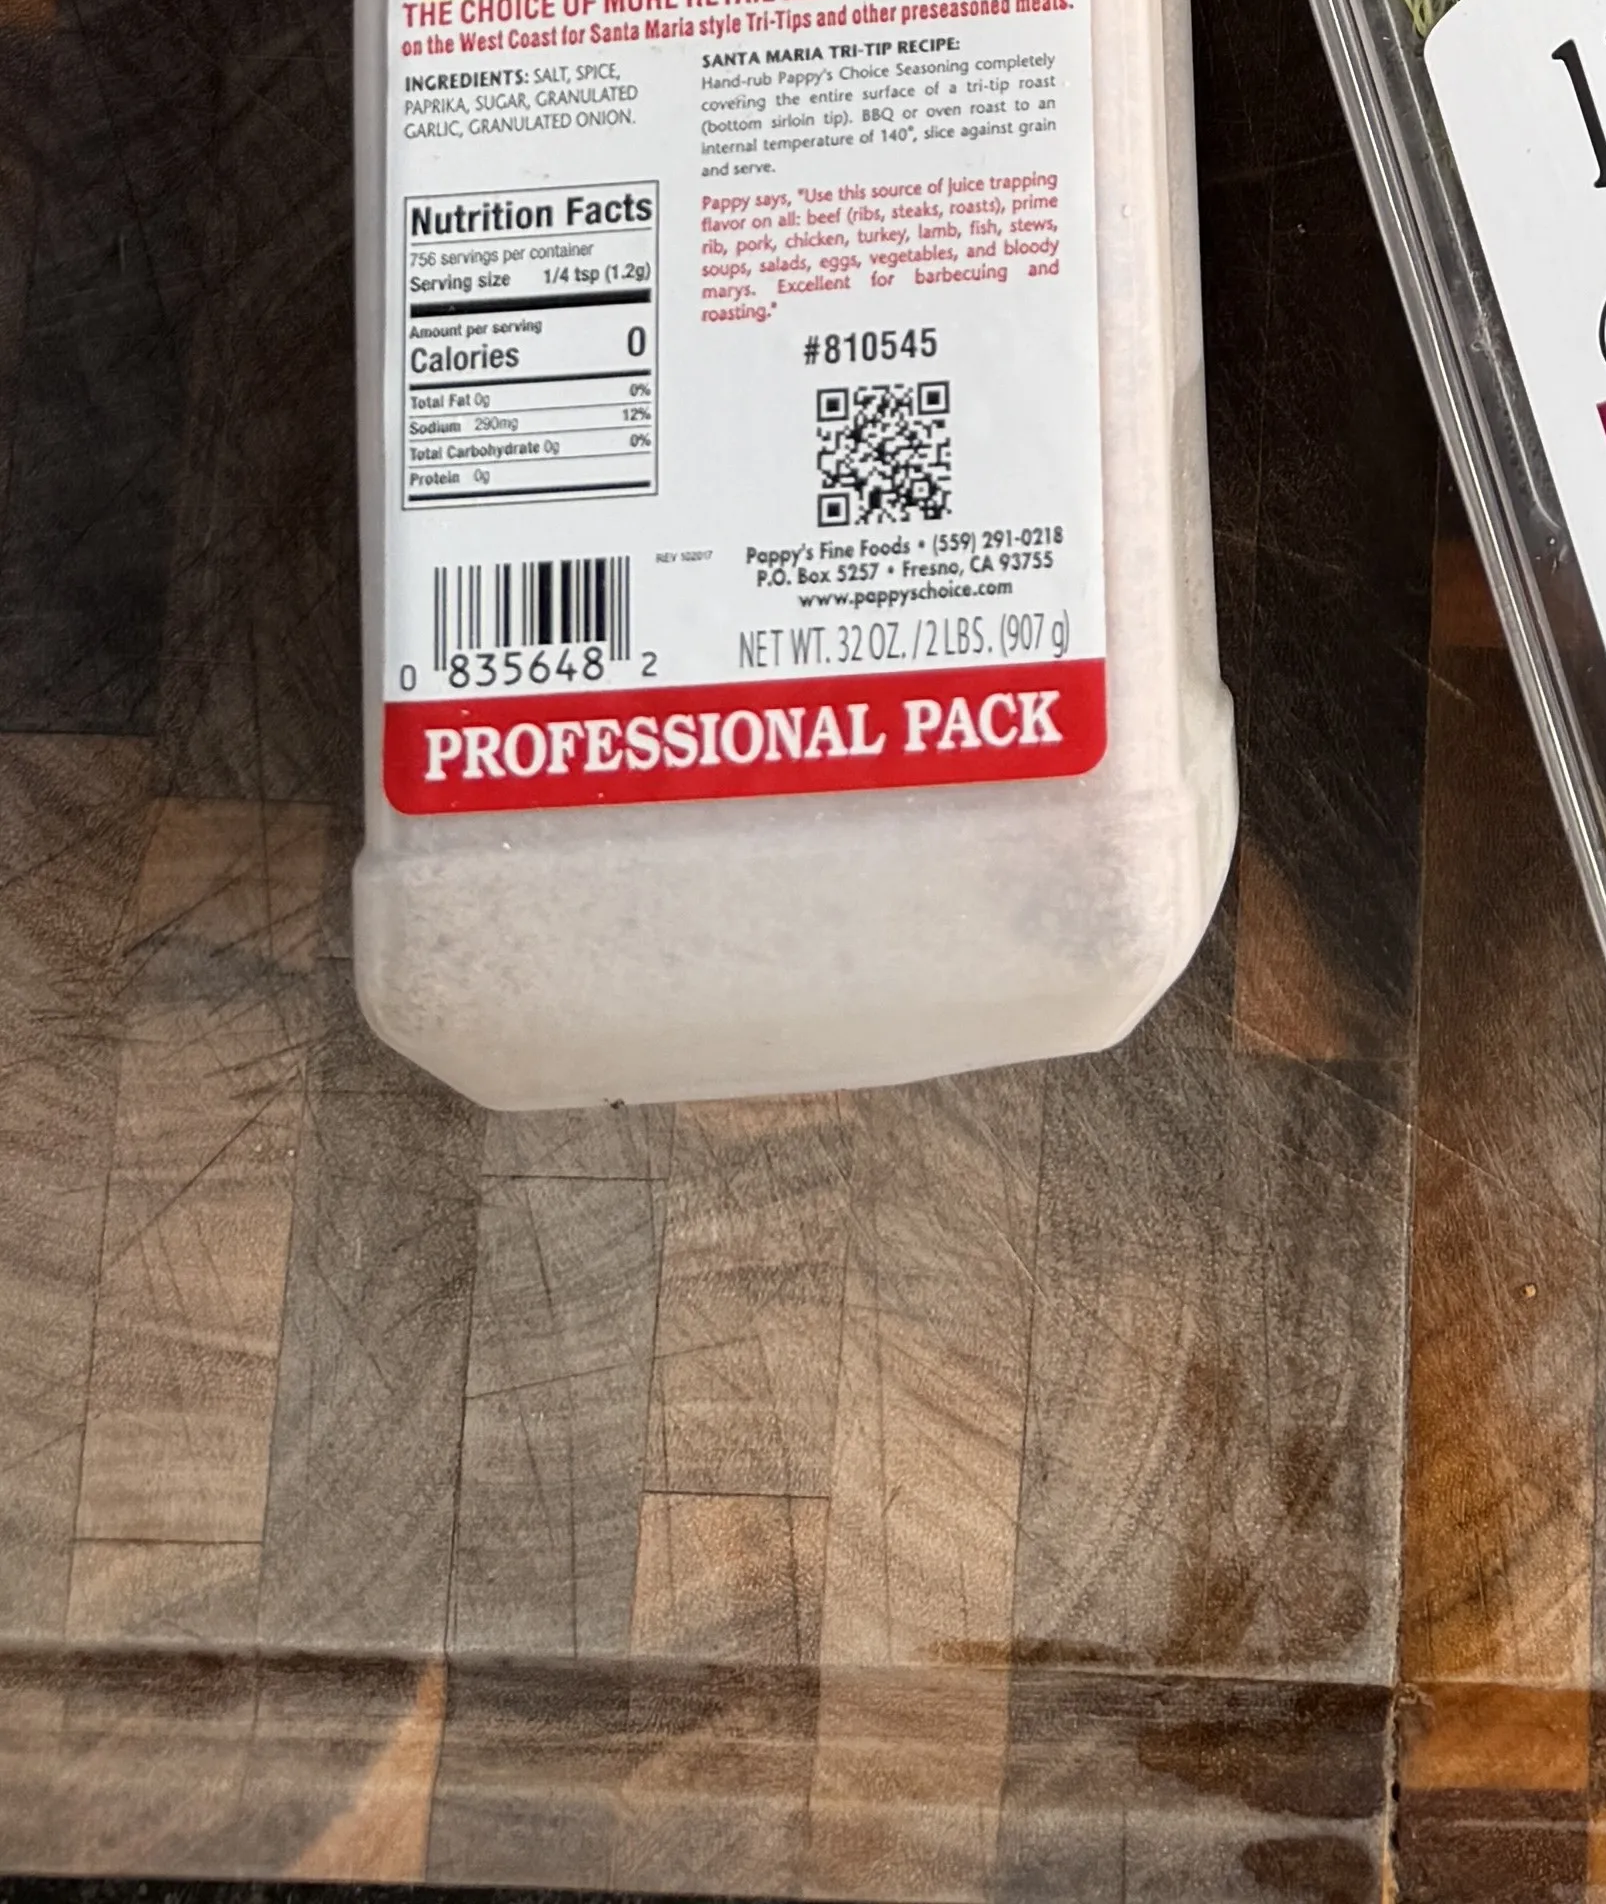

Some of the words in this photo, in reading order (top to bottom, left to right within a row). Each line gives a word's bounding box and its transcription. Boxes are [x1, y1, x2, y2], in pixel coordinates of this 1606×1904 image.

[404, 68, 530, 93] INGREDIENTS:
[533, 65, 572, 86] SALT,
[575, 62, 621, 82] SPICE,
[410, 199, 555, 237] Nutrition
[566, 193, 653, 226] Facts
[410, 344, 520, 374] Calories
[626, 325, 647, 358] 0
[803, 327, 939, 365] #810545
[745, 543, 815, 569] Pappy's
[819, 541, 856, 561] Fine
[859, 535, 911, 558] Foods
[932, 532, 978, 554] (559)
[981, 525, 1065, 550] 291-0218
[799, 578, 1013, 609] www.pappyschoice.com
[738, 627, 784, 670] NET
[790, 625, 832, 665] WT.
[837, 625, 865, 663] 32
[868, 621, 907, 661] OZ.
[943, 615, 993, 657] LBS.
[424, 702, 887, 782] PROFESSIONAL
[902, 689, 1063, 756] PACK
